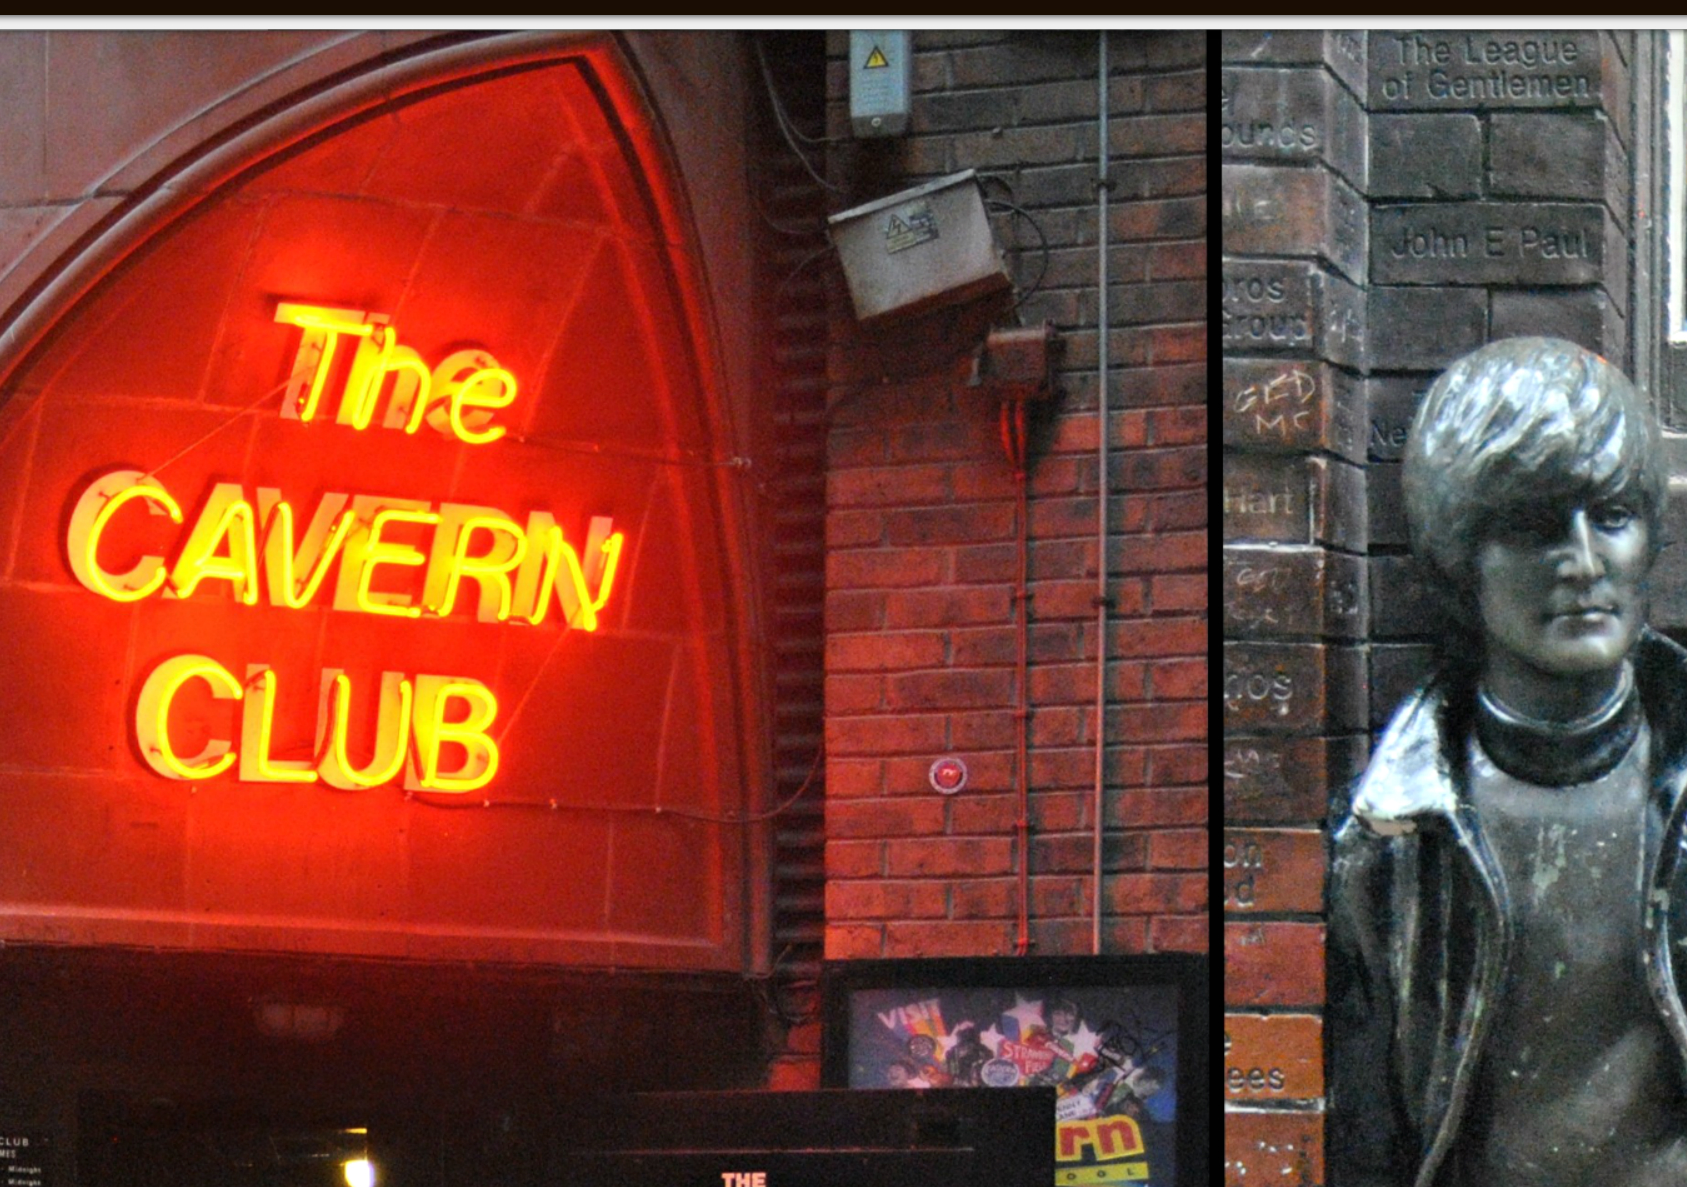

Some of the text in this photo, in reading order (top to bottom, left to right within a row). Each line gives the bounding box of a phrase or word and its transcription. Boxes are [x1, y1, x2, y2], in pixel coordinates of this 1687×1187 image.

[1393, 35, 1578, 69] The League
[1382, 70, 1590, 100] of Gentlemen
[1391, 227, 1587, 259] John E Paul
[274, 302, 517, 444] The
[67, 470, 623, 633] CAVERN
[136, 653, 500, 794] CLUB
[877, 998, 942, 1030] VISIT
